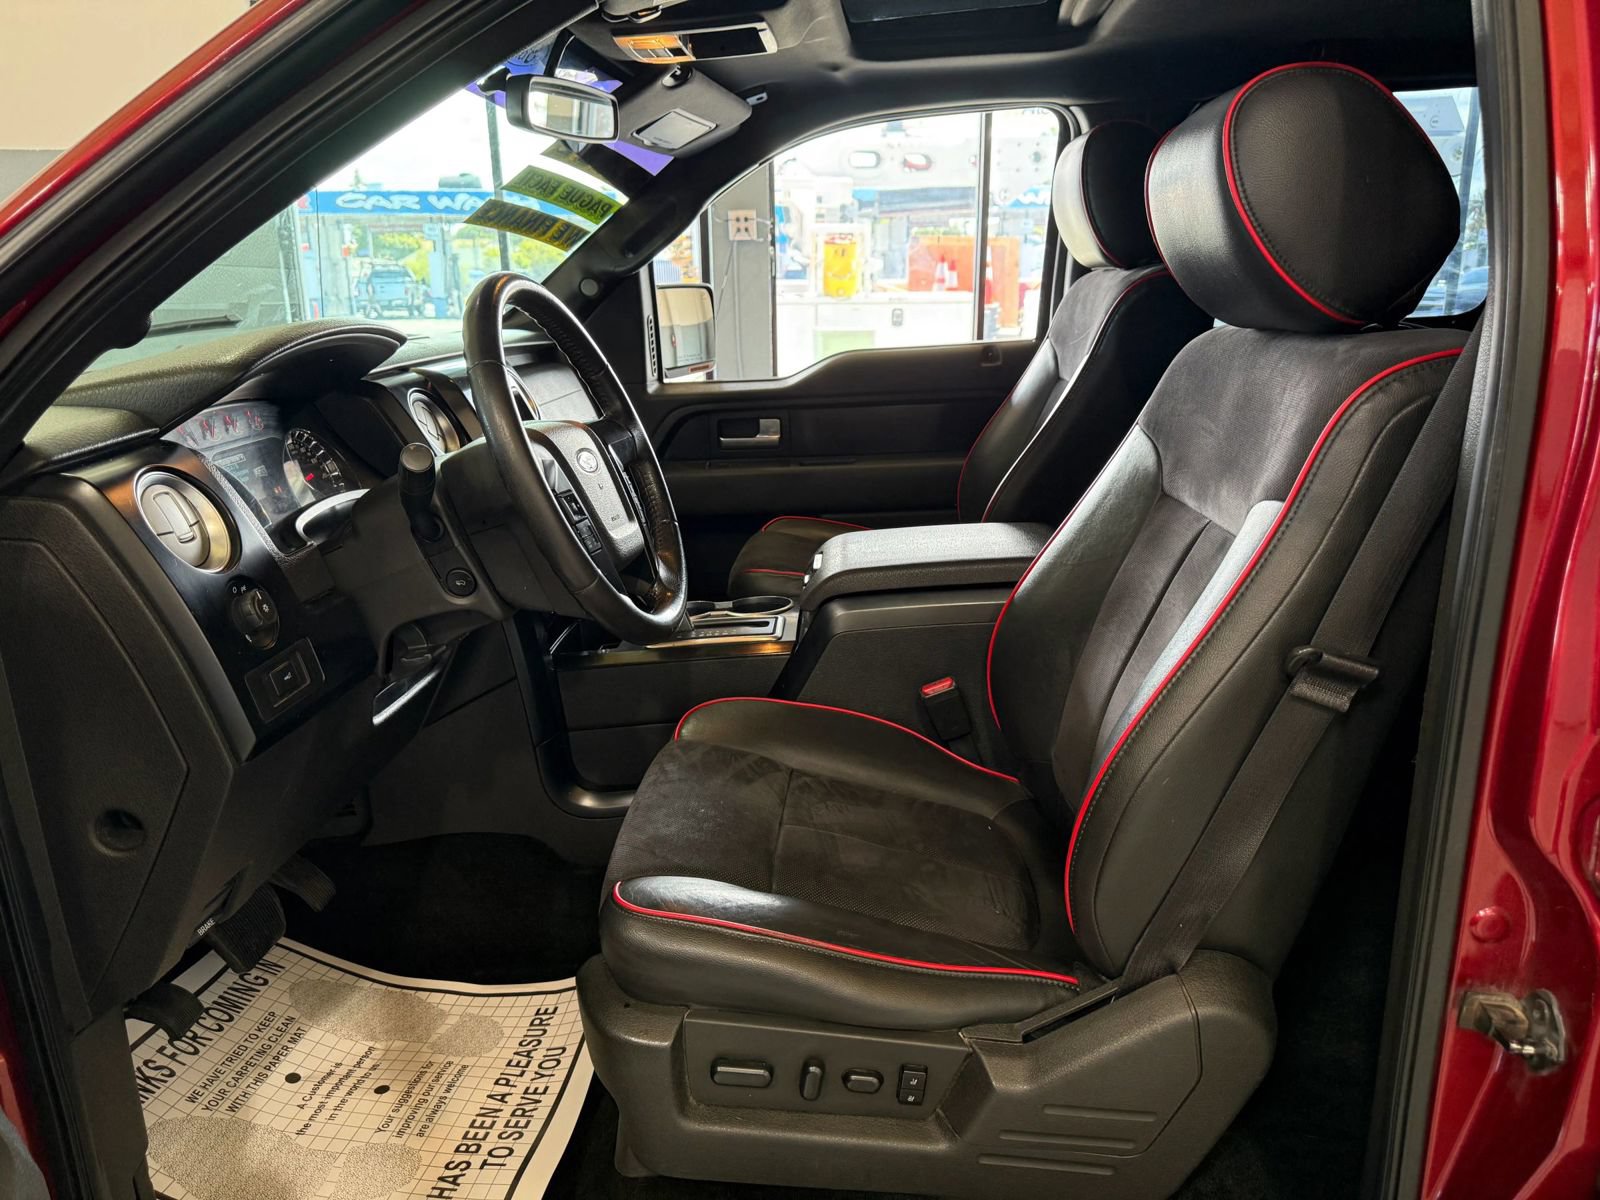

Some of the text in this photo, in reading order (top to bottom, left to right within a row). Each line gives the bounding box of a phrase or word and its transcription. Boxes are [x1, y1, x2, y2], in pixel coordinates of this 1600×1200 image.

[335, 191, 421, 211] CAR
[197, 918, 216, 936] BRAKE
[135, 958, 286, 1104] NKS FOR COMING IN
[185, 1011, 278, 1105] WE HAVE TRIED TO KEEP
[201, 1015, 297, 1113] YOUR CARPETING CLEAN
[225, 1026, 307, 1114] WITH THIS PAPER MAT
[295, 1045, 376, 1136] the most important person
[301, 1068, 338, 1105] Customer
[333, 1061, 343, 1071] is
[325, 1110, 335, 1122] in
[334, 1097, 348, 1114] the
[345, 1076, 366, 1100] world
[375, 1060, 435, 1134] Your suggestions for
[392, 1060, 454, 1138] improving our service
[416, 1064, 469, 1138] are always welcome
[426, 1006, 559, 1200] HAS BEEN A PLEASURE
[479, 1046, 567, 1170] TO SERVE YOU
